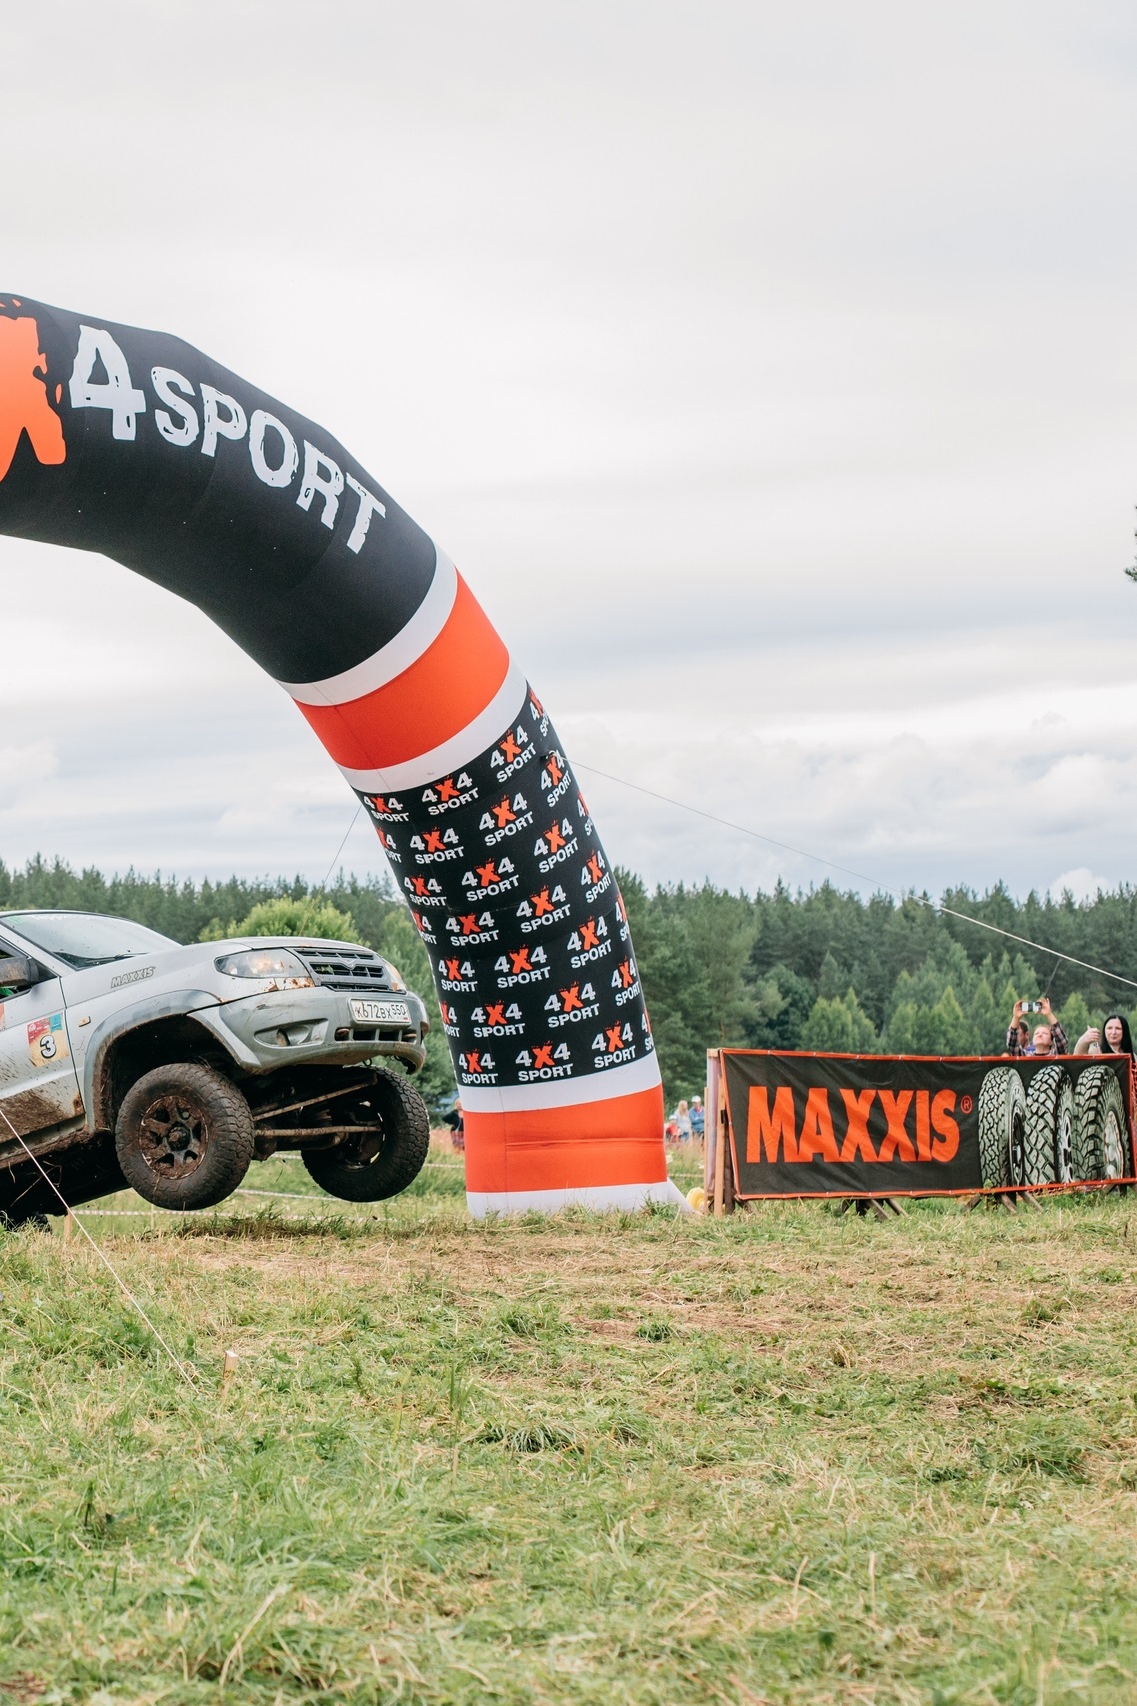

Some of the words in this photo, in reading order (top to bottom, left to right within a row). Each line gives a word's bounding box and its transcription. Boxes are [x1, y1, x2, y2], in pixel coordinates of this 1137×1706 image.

[151, 366, 386, 554] SPORT
[490, 725, 528, 768] 4X4
[497, 742, 537, 782] SPORT
[422, 772, 473, 802] 4X4
[364, 795, 403, 813] 4X4
[428, 787, 479, 815] SPORT
[479, 792, 527, 830] 4X4
[371, 810, 409, 822] SPORT
[484, 811, 534, 846] SPORT
[410, 827, 459, 852] 4X4
[534, 818, 573, 856] 4X4
[415, 846, 464, 864] SPORT
[539, 837, 579, 873] SPORT
[581, 849, 605, 885] 4X4
[404, 874, 442, 896] 4X4
[462, 857, 514, 887] 4X4
[409, 894, 447, 906] SPORT
[466, 875, 519, 901] SPORT
[516, 885, 566, 917] 4X4
[585, 872, 611, 903] SPORT
[446, 912, 494, 935] 4X4
[520, 904, 571, 933] SPORT
[450, 930, 499, 946] SPORT
[567, 915, 607, 951] 4X4
[494, 944, 547, 974] 4X4
[571, 939, 611, 968] SPORT
[111, 966, 154, 988] MAXXIS
[438, 955, 475, 980] 4X4
[497, 966, 550, 988] SPORT
[611, 955, 636, 988] 4X4
[441, 979, 477, 992] SPORT
[544, 981, 596, 1012] 4X4
[615, 981, 640, 1006] SPORT
[471, 999, 522, 1026] 4X4
[548, 1003, 599, 1028] SPORT
[474, 1023, 525, 1037] SPORT
[592, 1020, 633, 1052] 4X4
[40, 1034, 57, 1059] 3
[516, 1040, 570, 1069] 4X4
[594, 1045, 636, 1068] SPORT
[459, 1048, 495, 1073] 4X4
[518, 1063, 573, 1081] SPORT
[461, 1073, 498, 1084] SPORT
